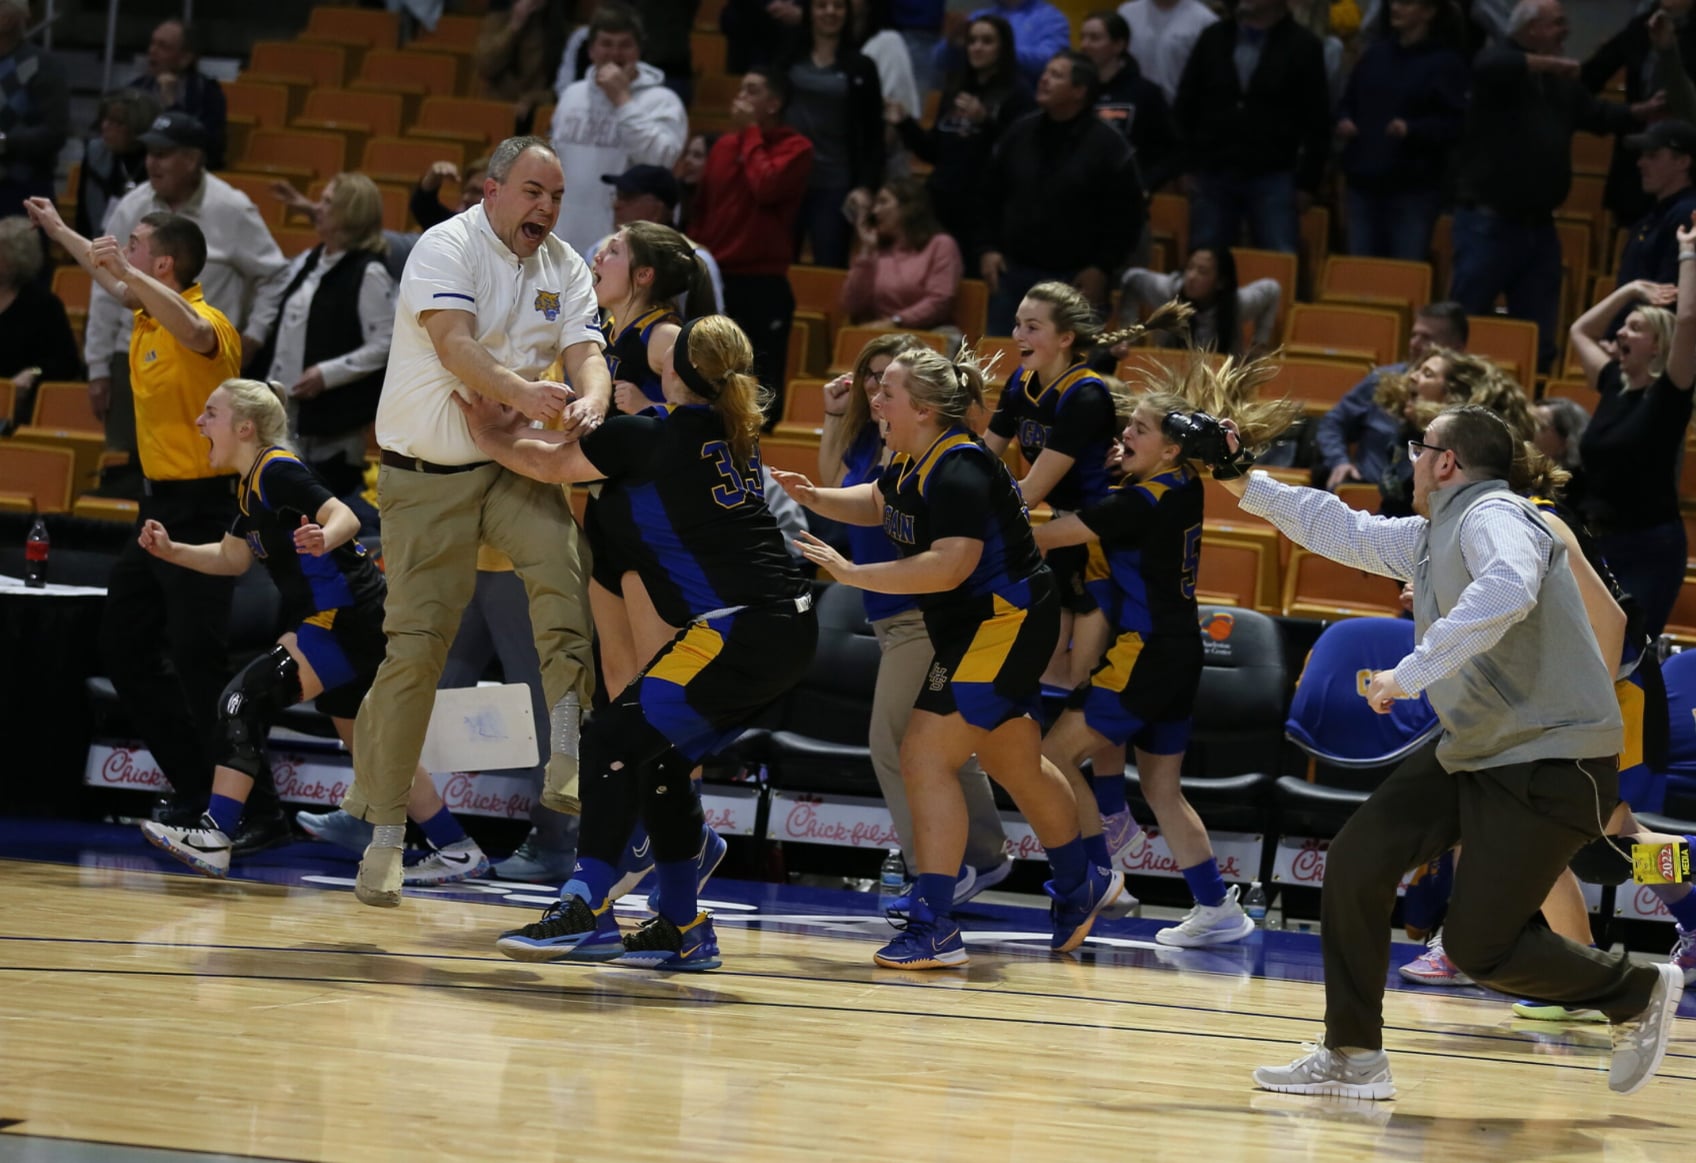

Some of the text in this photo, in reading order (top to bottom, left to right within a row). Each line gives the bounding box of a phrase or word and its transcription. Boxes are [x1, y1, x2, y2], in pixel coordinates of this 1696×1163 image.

[701, 440, 765, 509] 33
[1661, 848, 1673, 878] 2022
[1680, 849, 1690, 876] MEDIA
